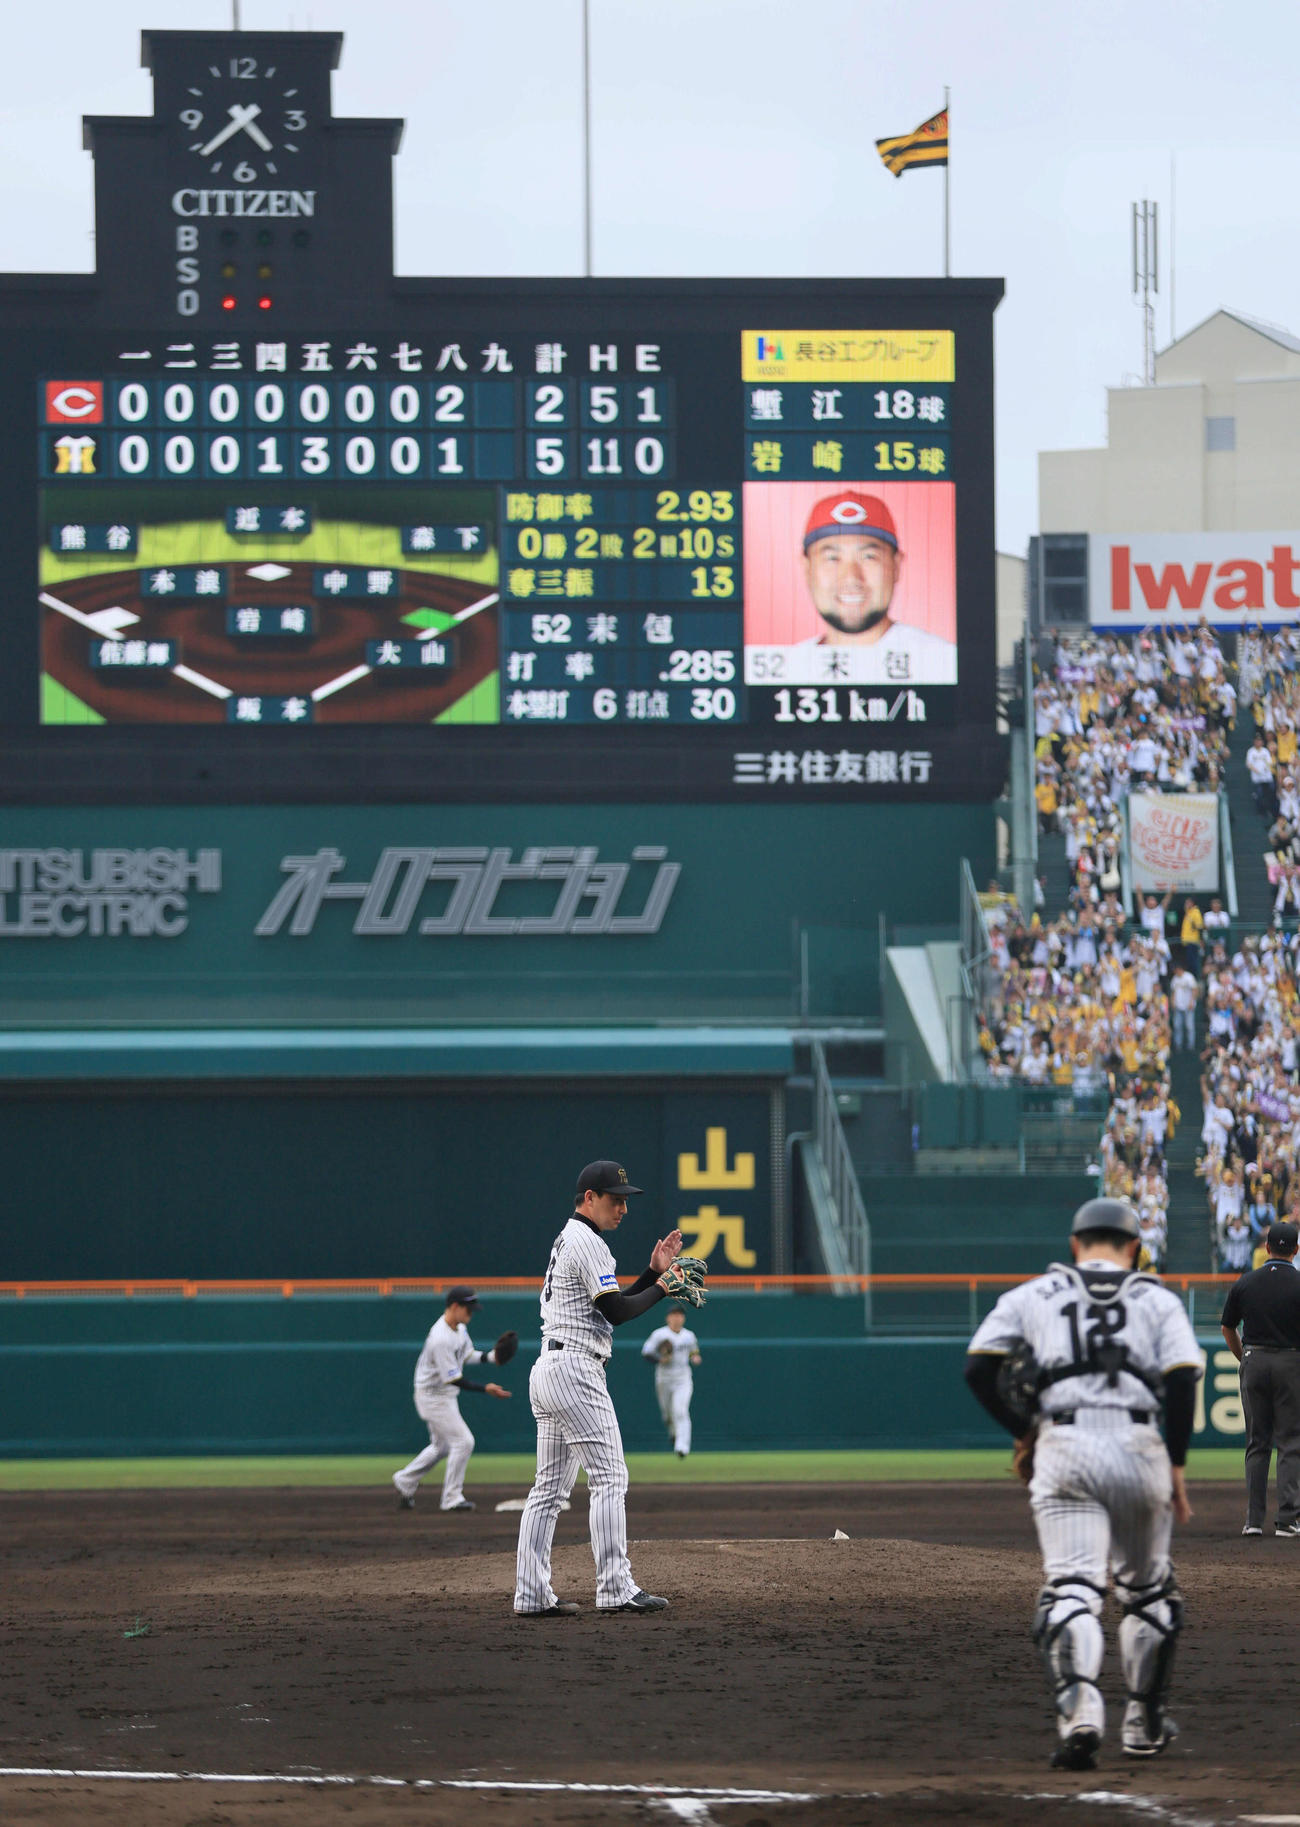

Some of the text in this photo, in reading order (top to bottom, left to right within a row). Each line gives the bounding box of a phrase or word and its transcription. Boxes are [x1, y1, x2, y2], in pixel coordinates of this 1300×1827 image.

[230, 58, 257, 78] 12
[179, 109, 307, 131] 9 3
[233, 161, 257, 183] 6
[171, 188, 316, 216] CITIZEN
[176, 225, 199, 251] B
[176, 257, 200, 284] S
[164, 343, 197, 368] 二
[209, 342, 242, 369] 三
[256, 342, 286, 372] 四
[300, 342, 333, 371] 五
[345, 342, 377, 371] 六
[391, 342, 422, 372] 七
[435, 344, 468, 372] 八
[480, 343, 513, 372] 九
[535, 343, 567, 373] 計
[589, 344, 617, 372] H
[635, 344, 661, 372] E
[119, 384, 148, 421] 0
[164, 384, 194, 422] 0
[209, 384, 239, 422] 0
[254, 384, 284, 422] 0
[300, 385, 330, 422] 0
[345, 385, 375, 422] 0
[390, 385, 420, 422] 0
[435, 385, 464, 421] 2
[535, 385, 564, 421] 2
[590, 387, 619, 422] 5
[637, 387, 661, 421] 1
[119, 436, 664, 474] 0 0 0 1 3 0 0 1 5 11 0
[507, 490, 734, 521] 防御率 2.93
[691, 566, 734, 597] 13
[1111, 545, 1300, 611] Iwat
[531, 613, 572, 643] 52
[659, 650, 735, 682] .285
[753, 653, 784, 678] 52
[593, 688, 618, 720] 6
[690, 688, 735, 720] 30
[733, 750, 932, 784] 三井住友銀行
[256, 846, 681, 935] オーロラビジョン
[677, 1127, 757, 1268] 山九
